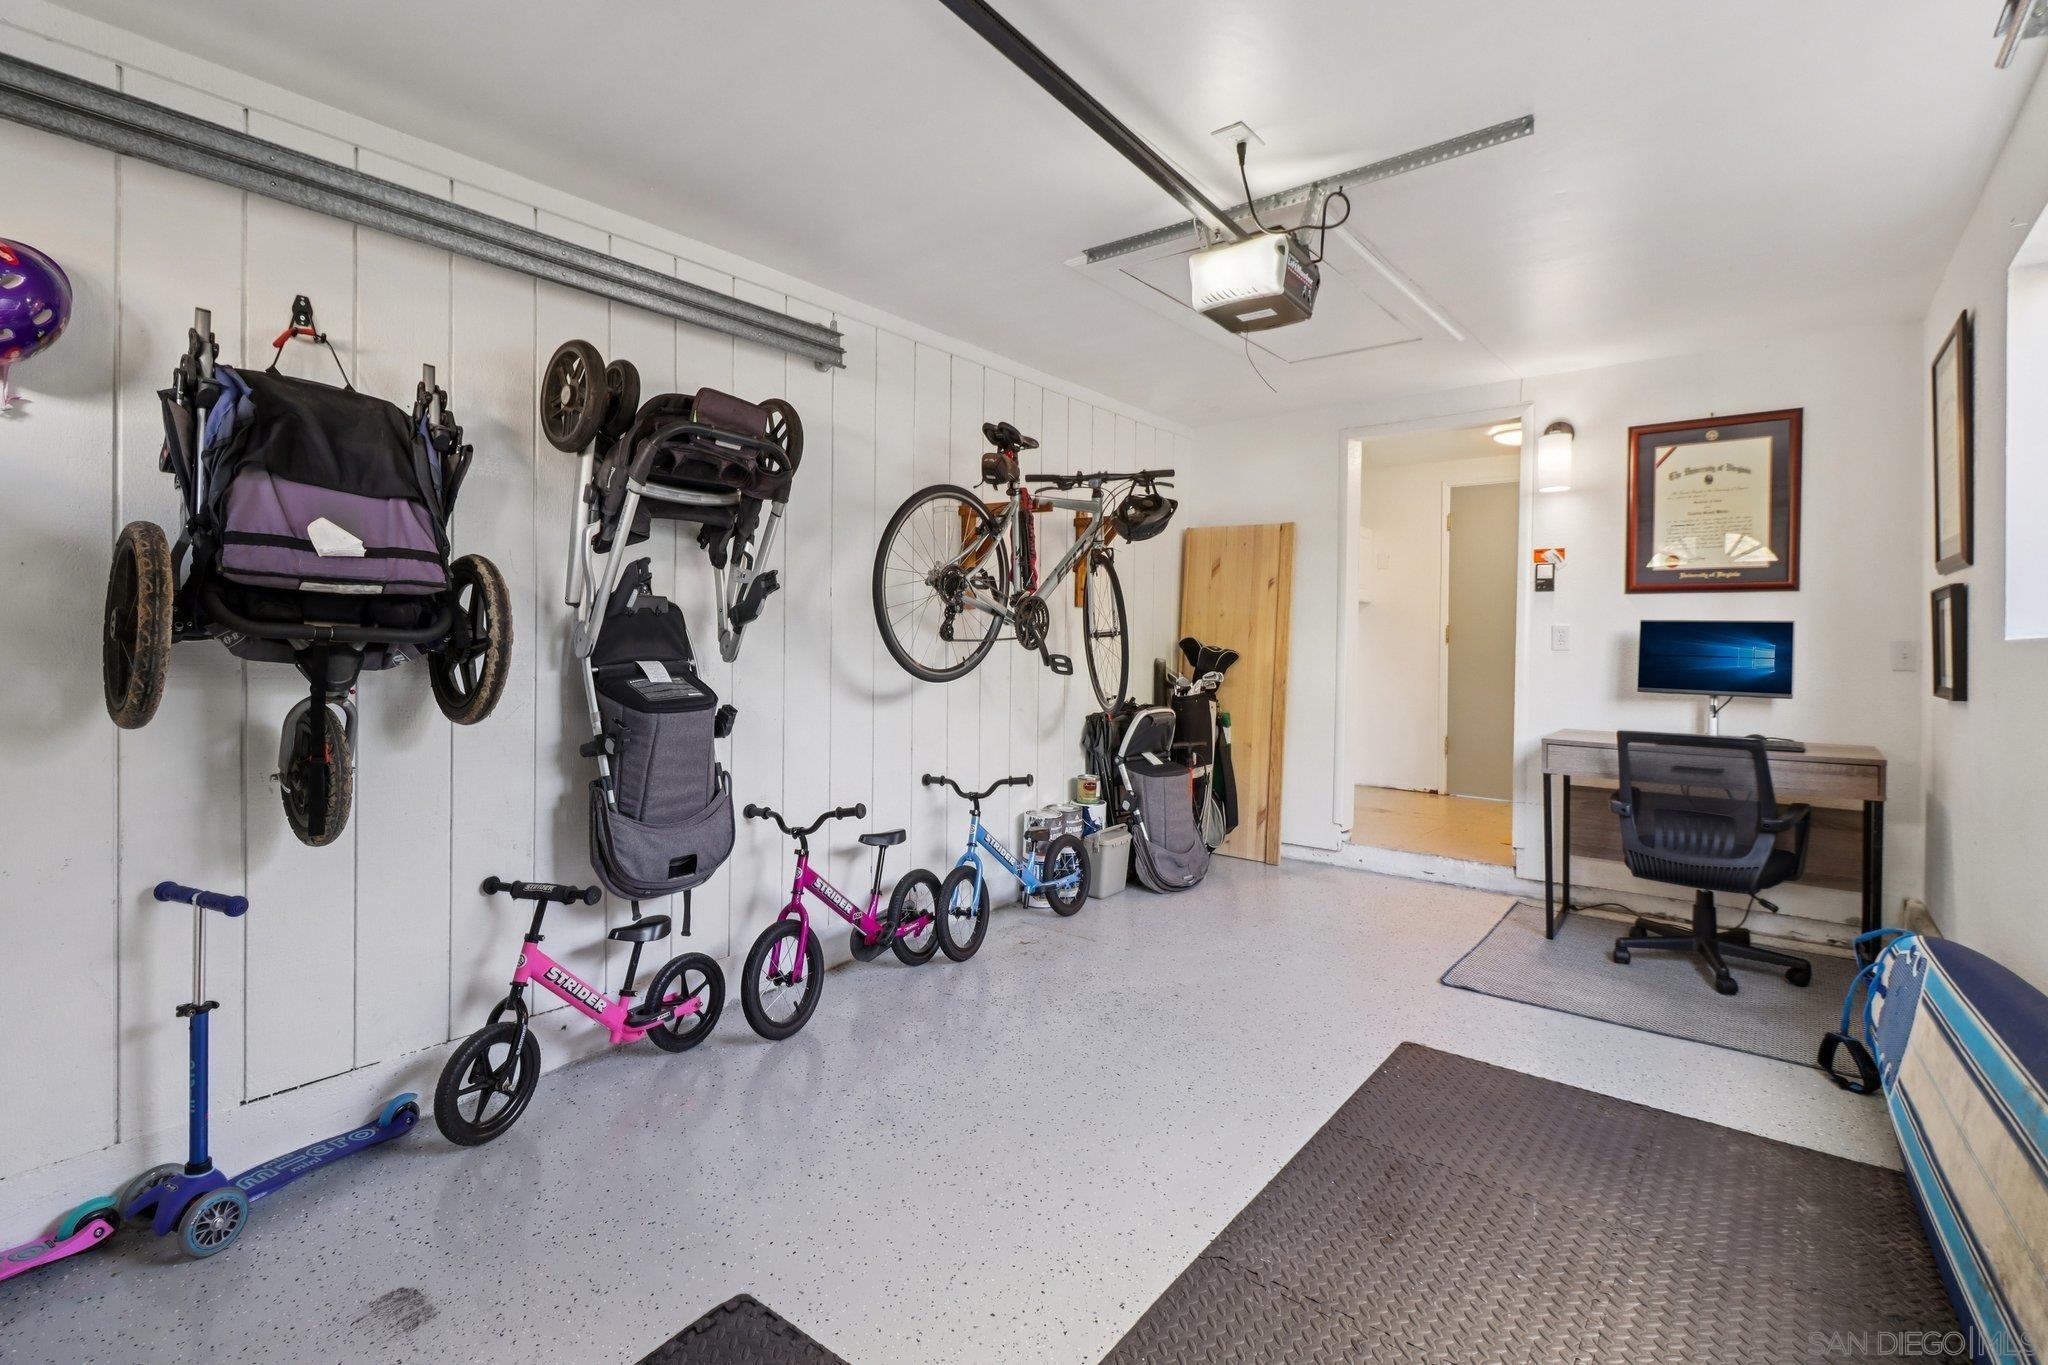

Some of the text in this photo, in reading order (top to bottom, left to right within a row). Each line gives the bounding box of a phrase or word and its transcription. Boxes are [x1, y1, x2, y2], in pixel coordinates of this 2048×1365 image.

[985, 834, 1017, 866] STRIDER
[523, 883, 558, 893] STRIDER
[814, 878, 854, 914] STRIDER
[547, 966, 608, 1014] STRIDER
[236, 1128, 376, 1190] micro
[291, 1156, 323, 1174] mini
